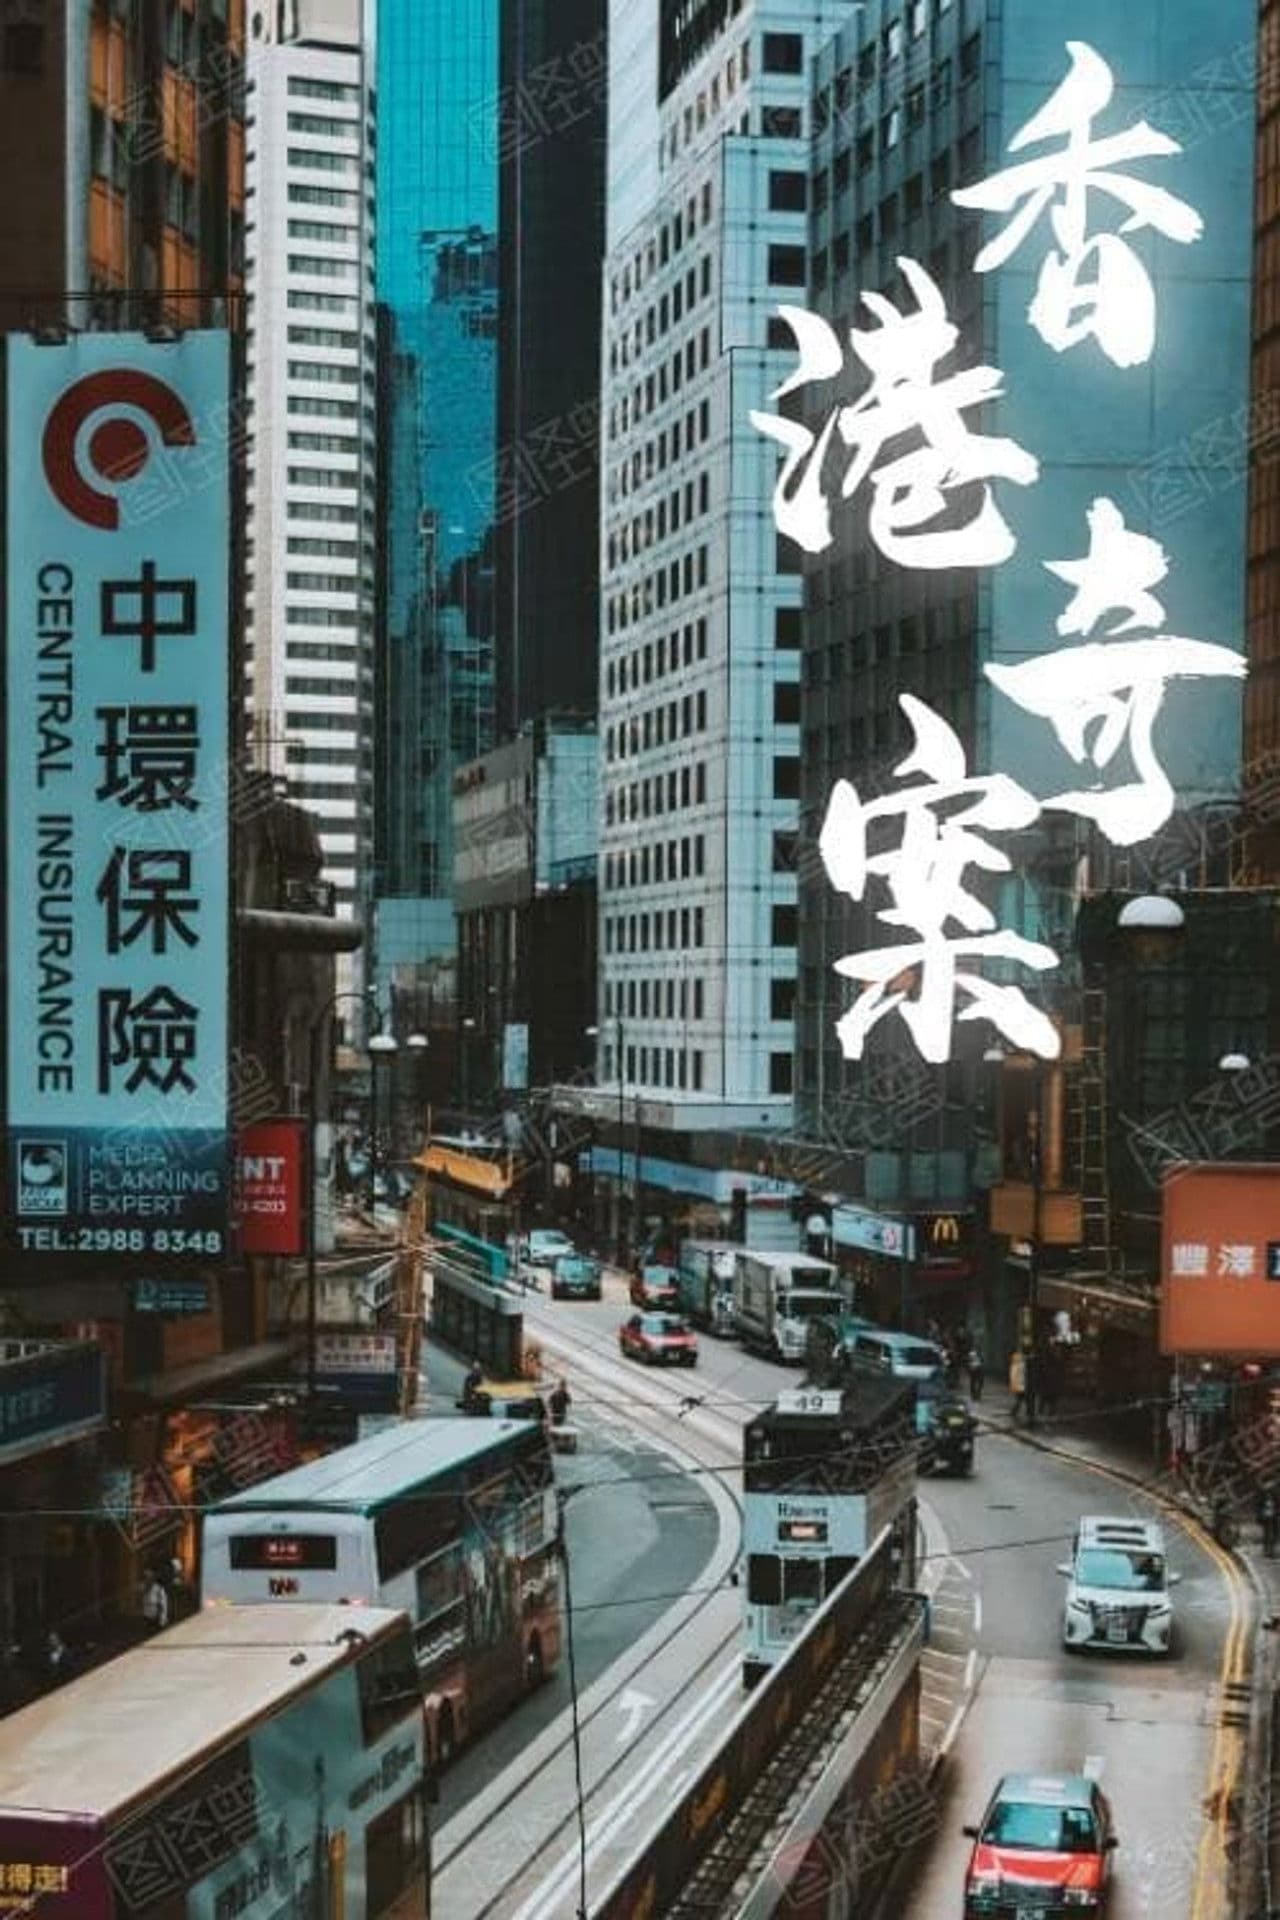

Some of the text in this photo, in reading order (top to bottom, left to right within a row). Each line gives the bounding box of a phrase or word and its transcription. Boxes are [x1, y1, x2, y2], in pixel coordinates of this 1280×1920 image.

[36, 562, 75, 1093] CENTRAL INSURANCE
[95, 560, 201, 1096] 中環保險
[89, 1145, 168, 1167] MEDIA
[89, 1169, 220, 1193] PLANNING
[89, 1194, 185, 1216] EXPERT
[17, 1227, 223, 1254] TEL:2988 8348
